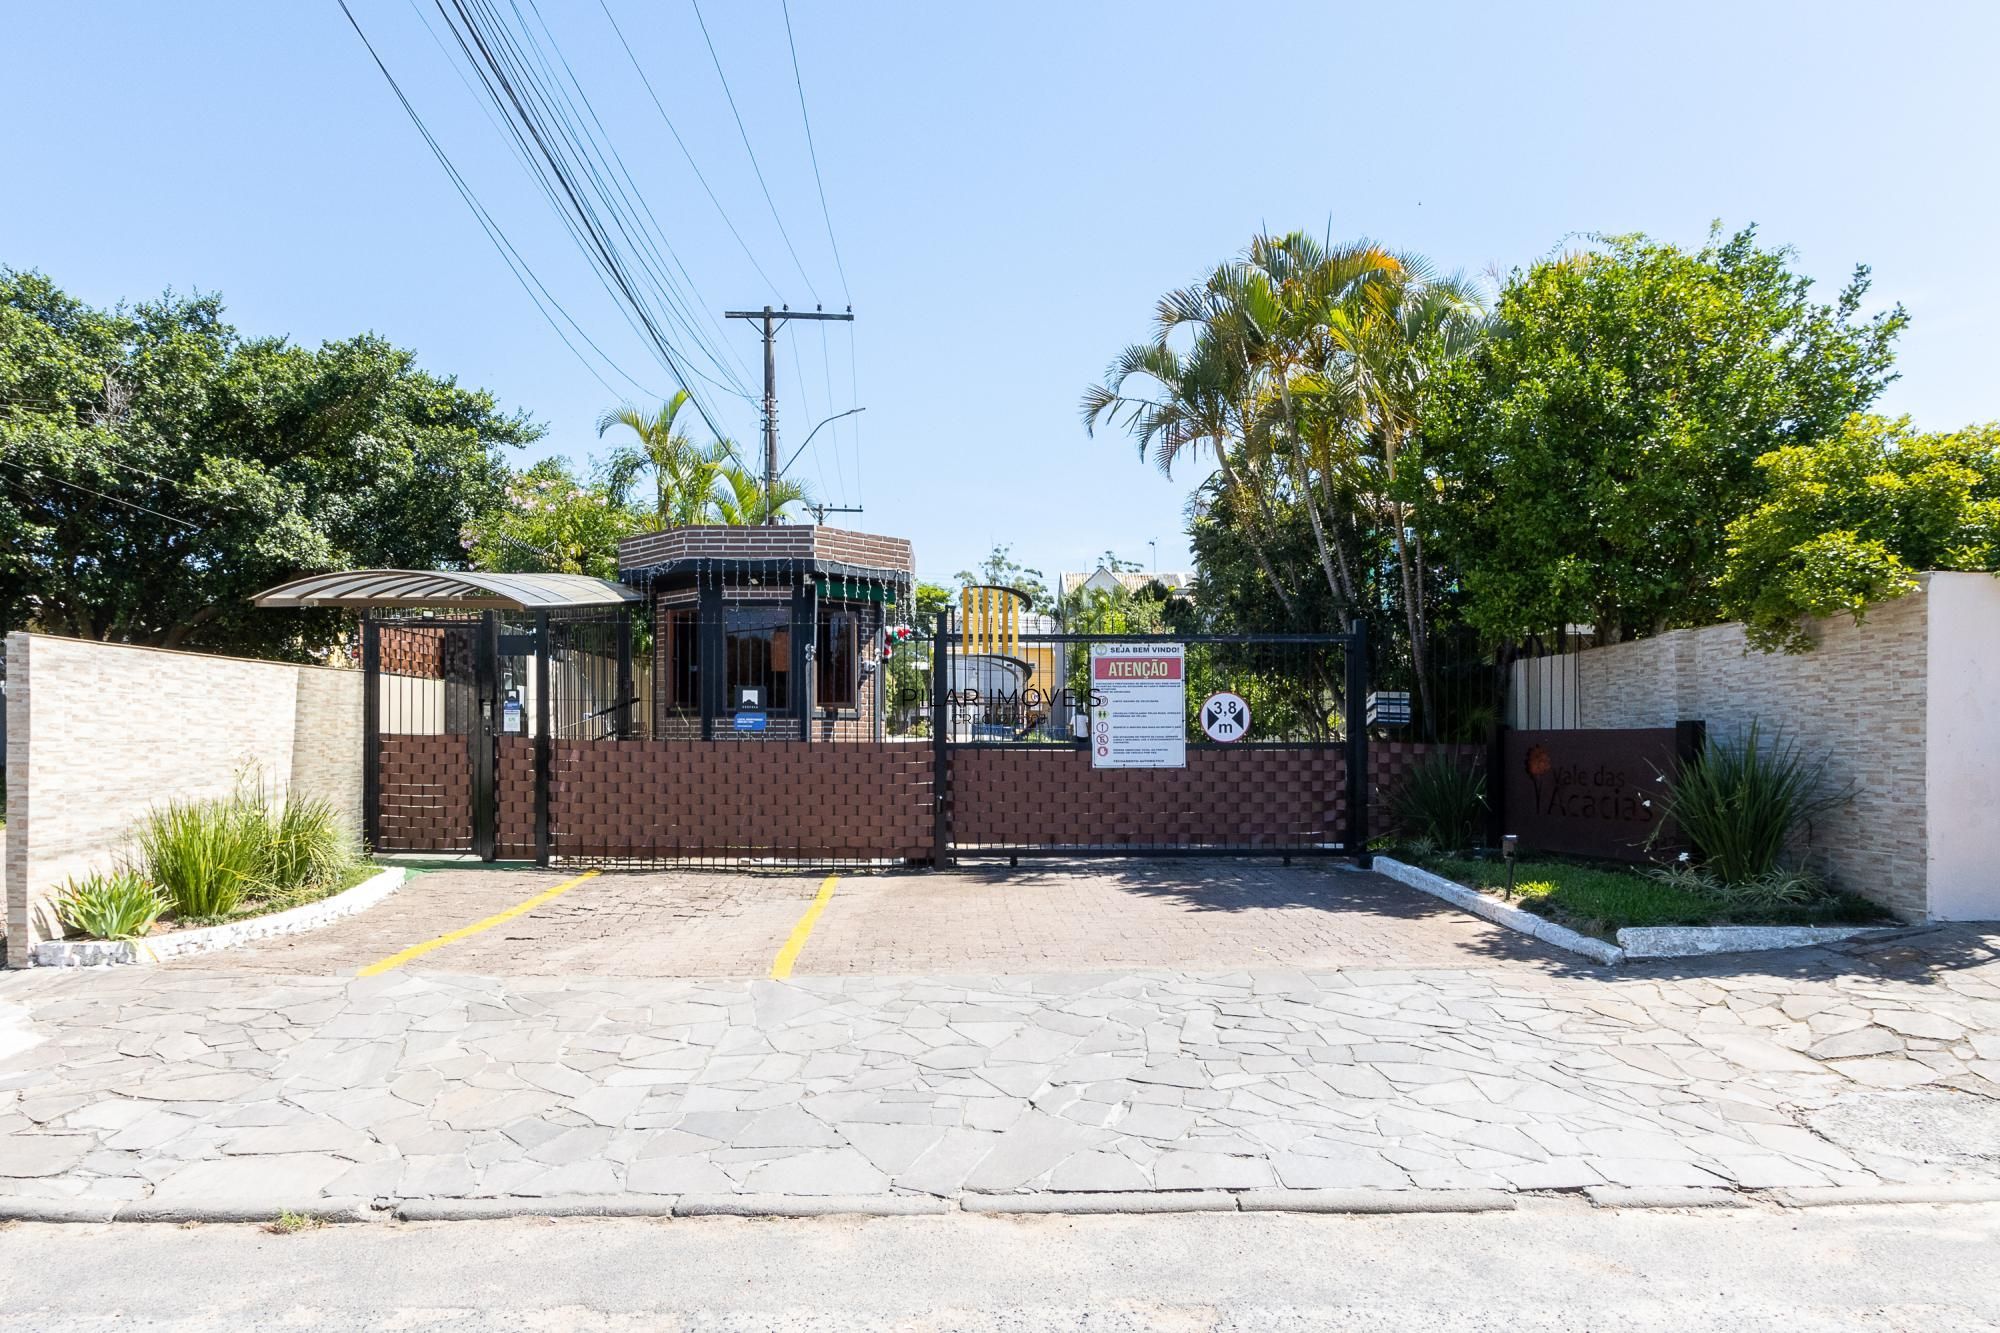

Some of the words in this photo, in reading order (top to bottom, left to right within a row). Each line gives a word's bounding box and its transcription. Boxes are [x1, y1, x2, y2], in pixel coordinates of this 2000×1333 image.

[1110, 646, 1131, 654] SEJA
[1132, 646, 1150, 654] BEM
[1152, 646, 1180, 654] VINDO!
[1108, 659, 1168, 679] ATENÇÃO
[1213, 701, 1237, 717] 3,8
[1218, 723, 1233, 734] m
[1552, 764, 1587, 786] Vale
[1593, 765, 1625, 788] das
